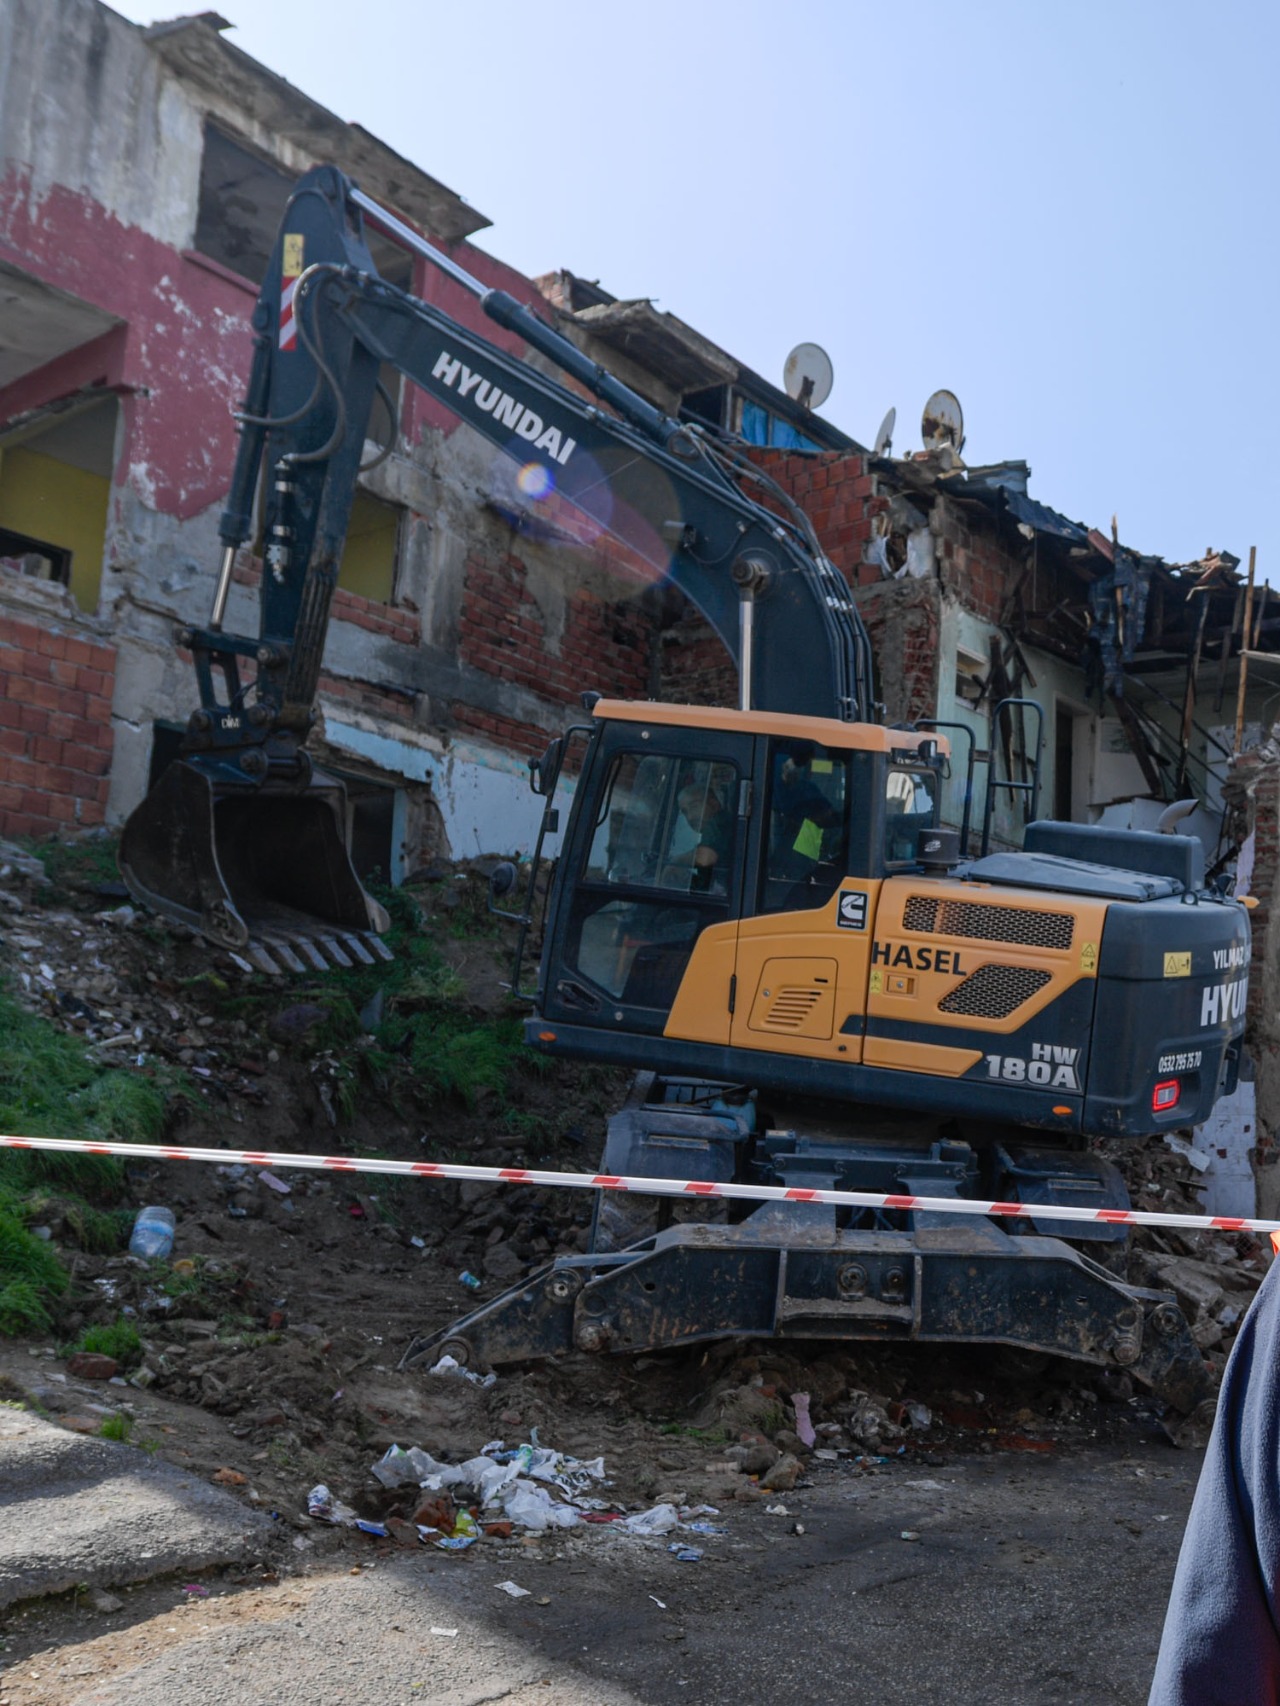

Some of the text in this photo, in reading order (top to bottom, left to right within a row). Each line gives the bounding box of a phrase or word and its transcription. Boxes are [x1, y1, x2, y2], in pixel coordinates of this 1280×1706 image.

[431, 351, 577, 466] HYUNDAI
[871, 941, 968, 976] HASEL
[1213, 946, 1244, 970] YILMAZ
[1032, 1042, 1078, 1066] HW
[1158, 1055, 1175, 1073] 0532
[985, 1054, 1078, 1089] 180A
